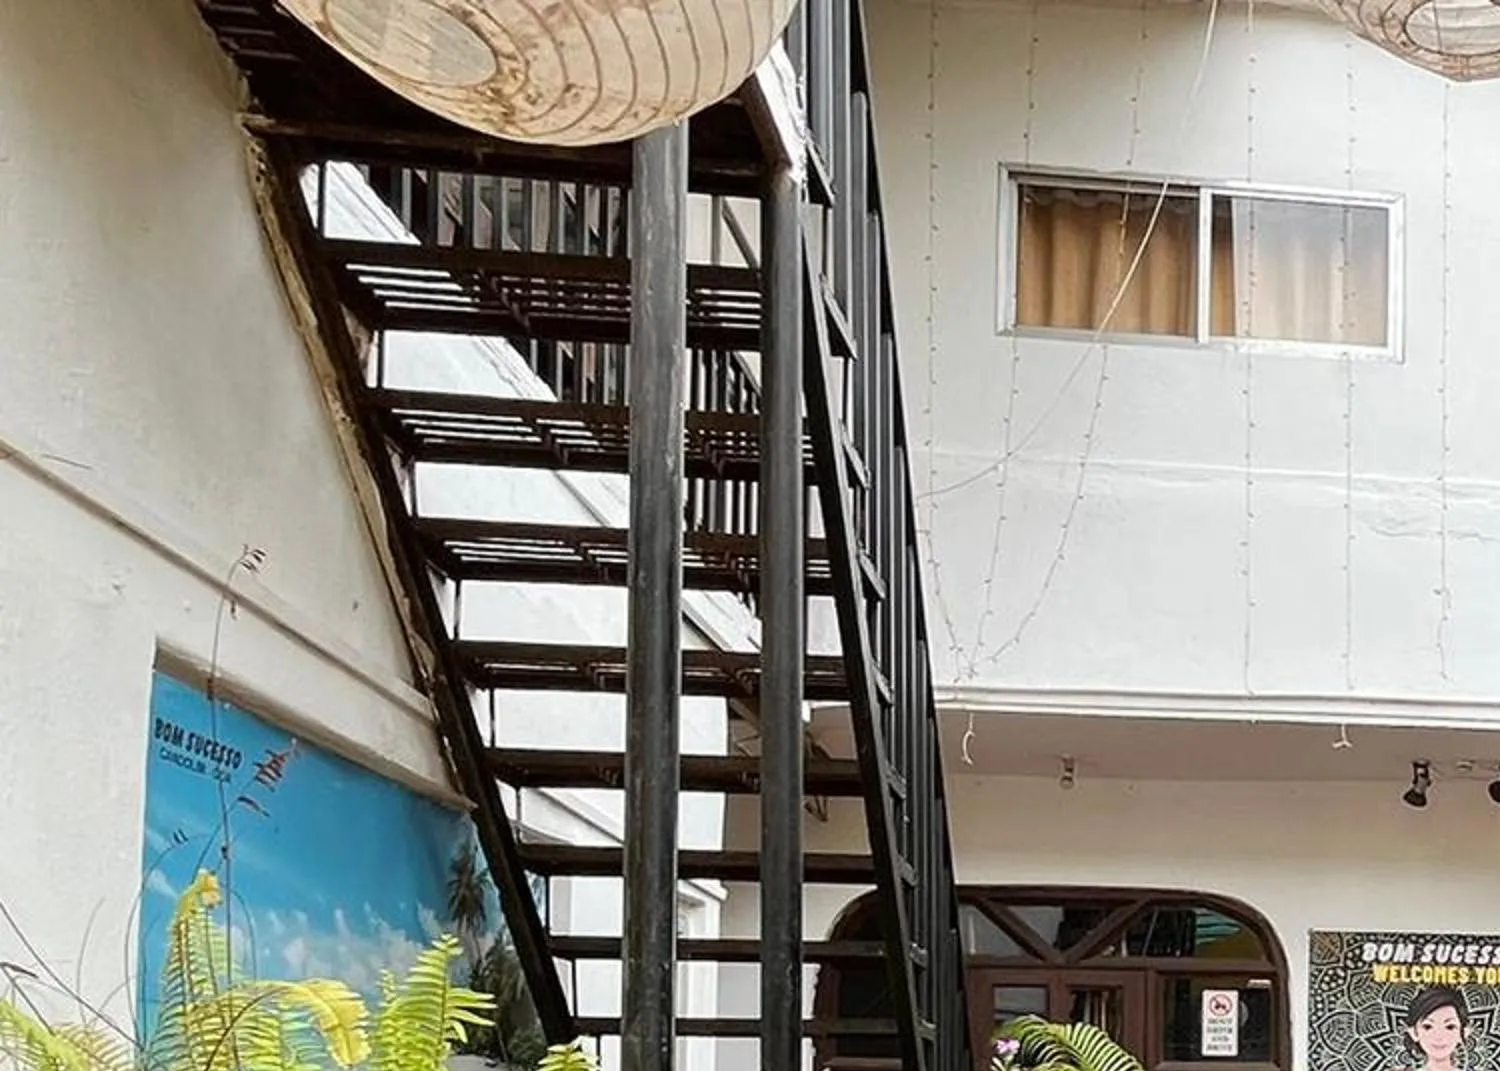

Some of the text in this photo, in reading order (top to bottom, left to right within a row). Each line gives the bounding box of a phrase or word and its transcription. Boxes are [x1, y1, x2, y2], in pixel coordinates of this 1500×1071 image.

[154, 717, 242, 770] BOM SUCESSO
[1362, 943, 1416, 963] BOM
[1372, 964, 1470, 984] WELCOMES
